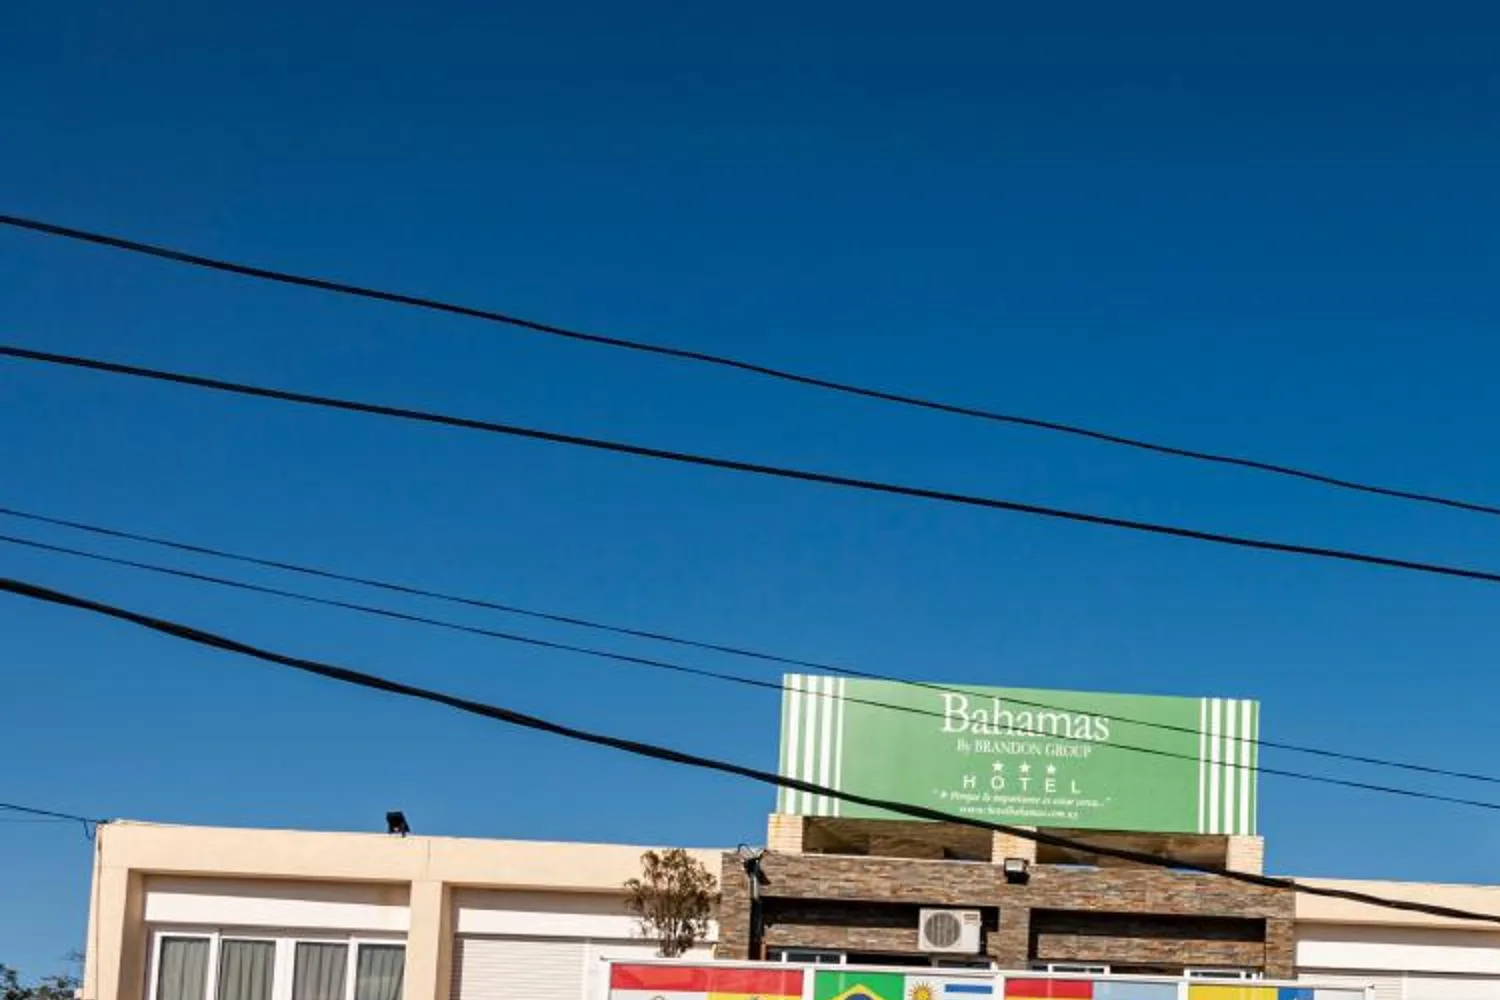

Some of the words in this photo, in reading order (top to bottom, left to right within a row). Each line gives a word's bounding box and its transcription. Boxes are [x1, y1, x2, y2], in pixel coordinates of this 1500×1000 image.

[940, 692, 1110, 741] Bahamas
[957, 738, 971, 755] By
[975, 739, 1041, 756] BRANDON
[1045, 743, 1092, 759] GROUP
[962, 774, 1082, 795] HOTEL
